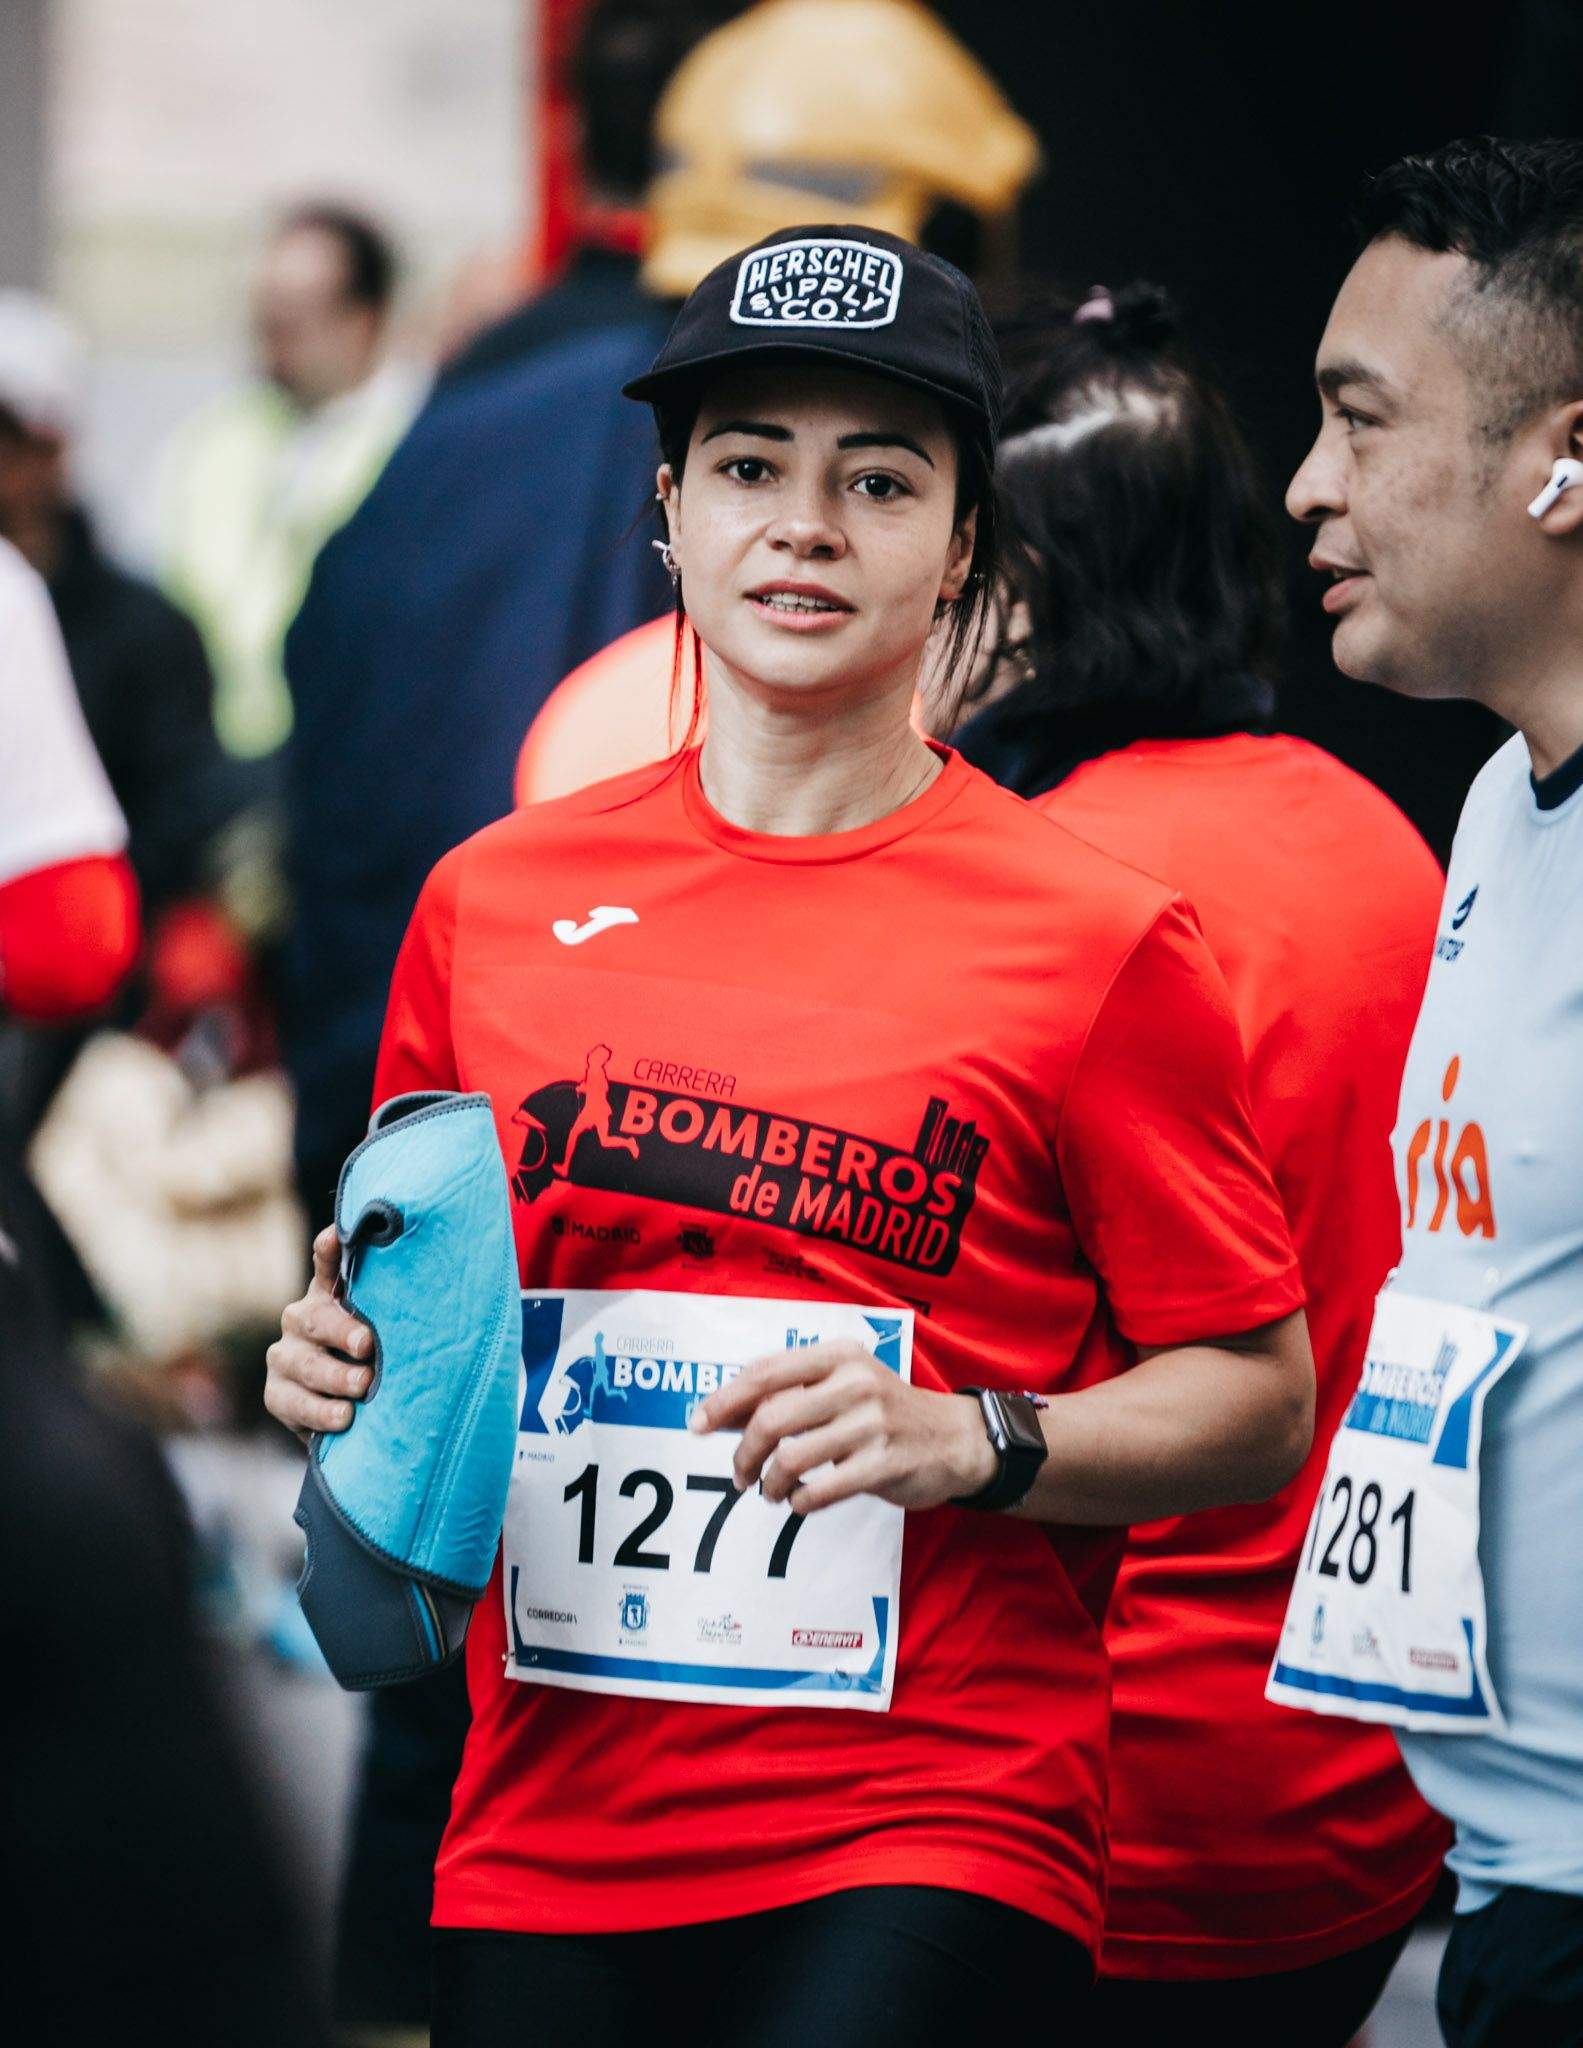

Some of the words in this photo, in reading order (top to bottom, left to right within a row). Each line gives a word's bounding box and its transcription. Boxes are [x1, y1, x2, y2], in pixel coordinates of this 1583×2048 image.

[747, 247, 893, 297] HERSCHEL
[750, 276, 885, 312] SUPPLY
[633, 1057, 737, 1098] CARRERA
[619, 1089, 964, 1217] BOMBEROS
[571, 1221, 641, 1246] MADRID
[729, 1165, 775, 1217] de
[789, 1177, 952, 1268] MADRID
